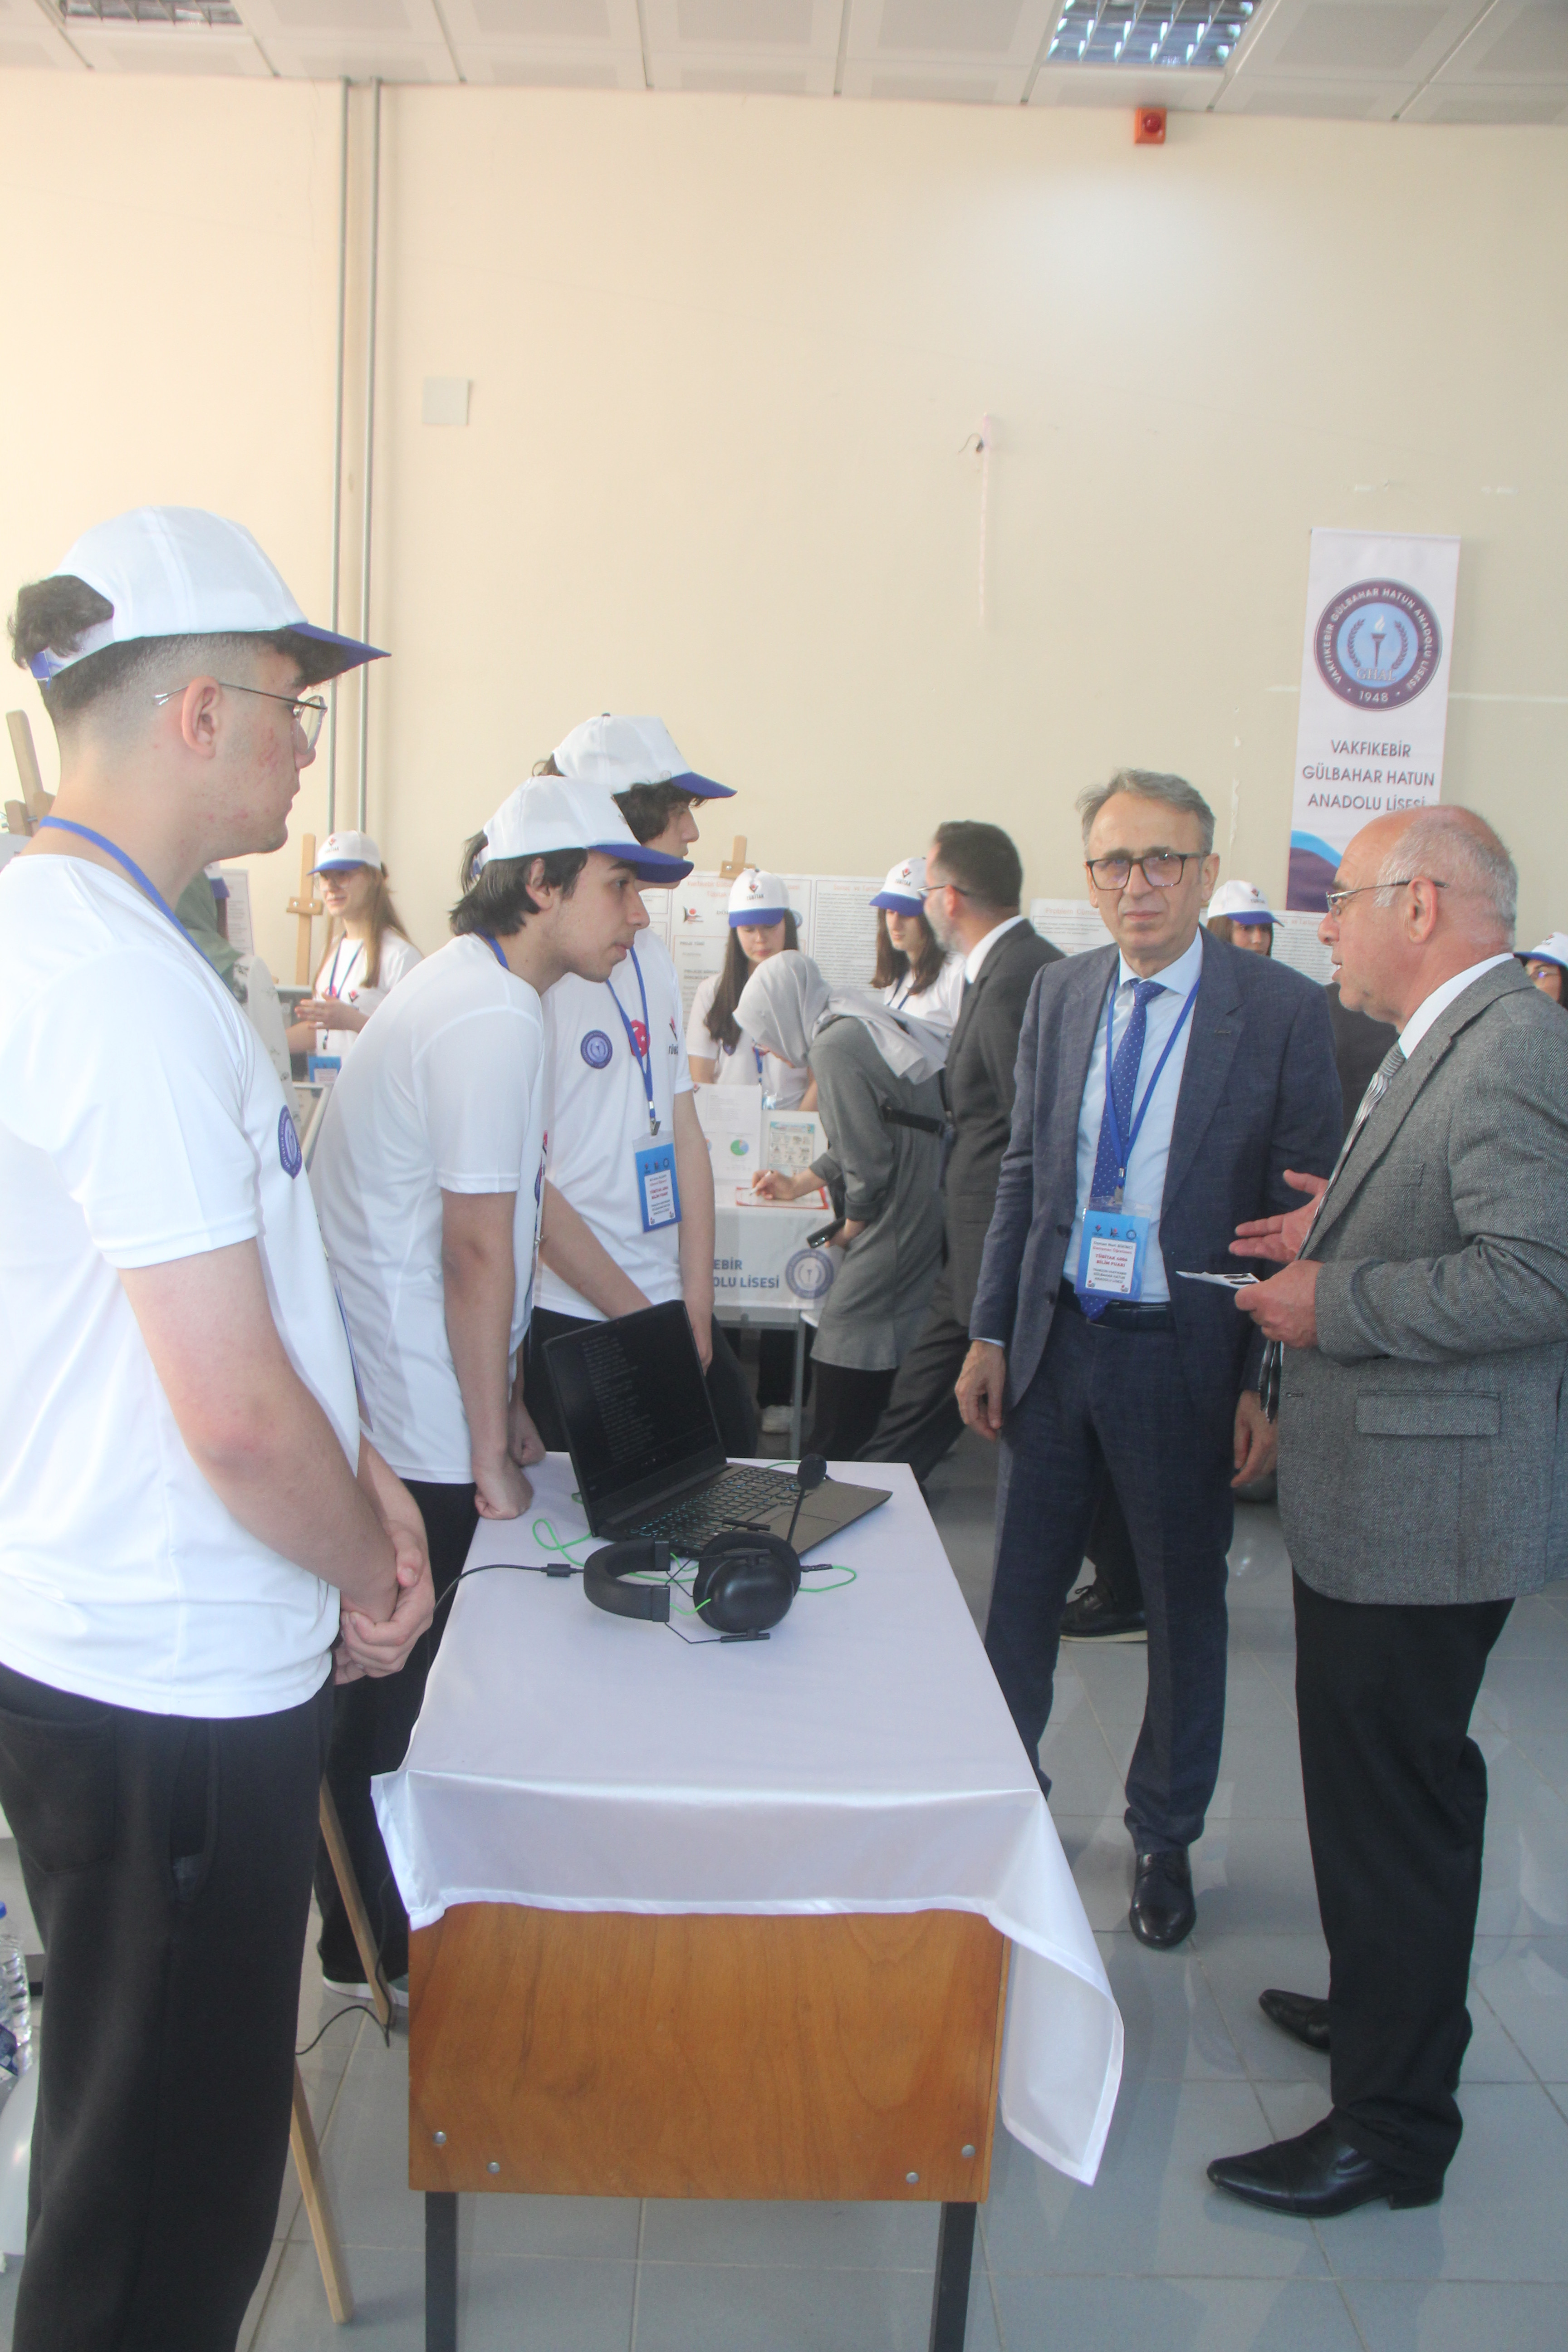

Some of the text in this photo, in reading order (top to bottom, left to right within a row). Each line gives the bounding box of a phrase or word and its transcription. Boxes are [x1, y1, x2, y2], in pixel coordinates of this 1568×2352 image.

[1331, 588, 1379, 622] GÜLBAHAR
[1382, 588, 1416, 609] HATUN
[1413, 608, 1433, 657] ANADOLU
[1323, 623, 1342, 684] VAKFIKEBİR
[1356, 667, 1396, 681] GHAL
[1360, 690, 1389, 702] 1948
[1331, 739, 1412, 758] VAKFIKEBİR
[1302, 762, 1435, 786] GÜLBAHAR HATUN
[1308, 793, 1382, 810] ANADOLU
[740, 1274, 779, 1289] LİSESİ
